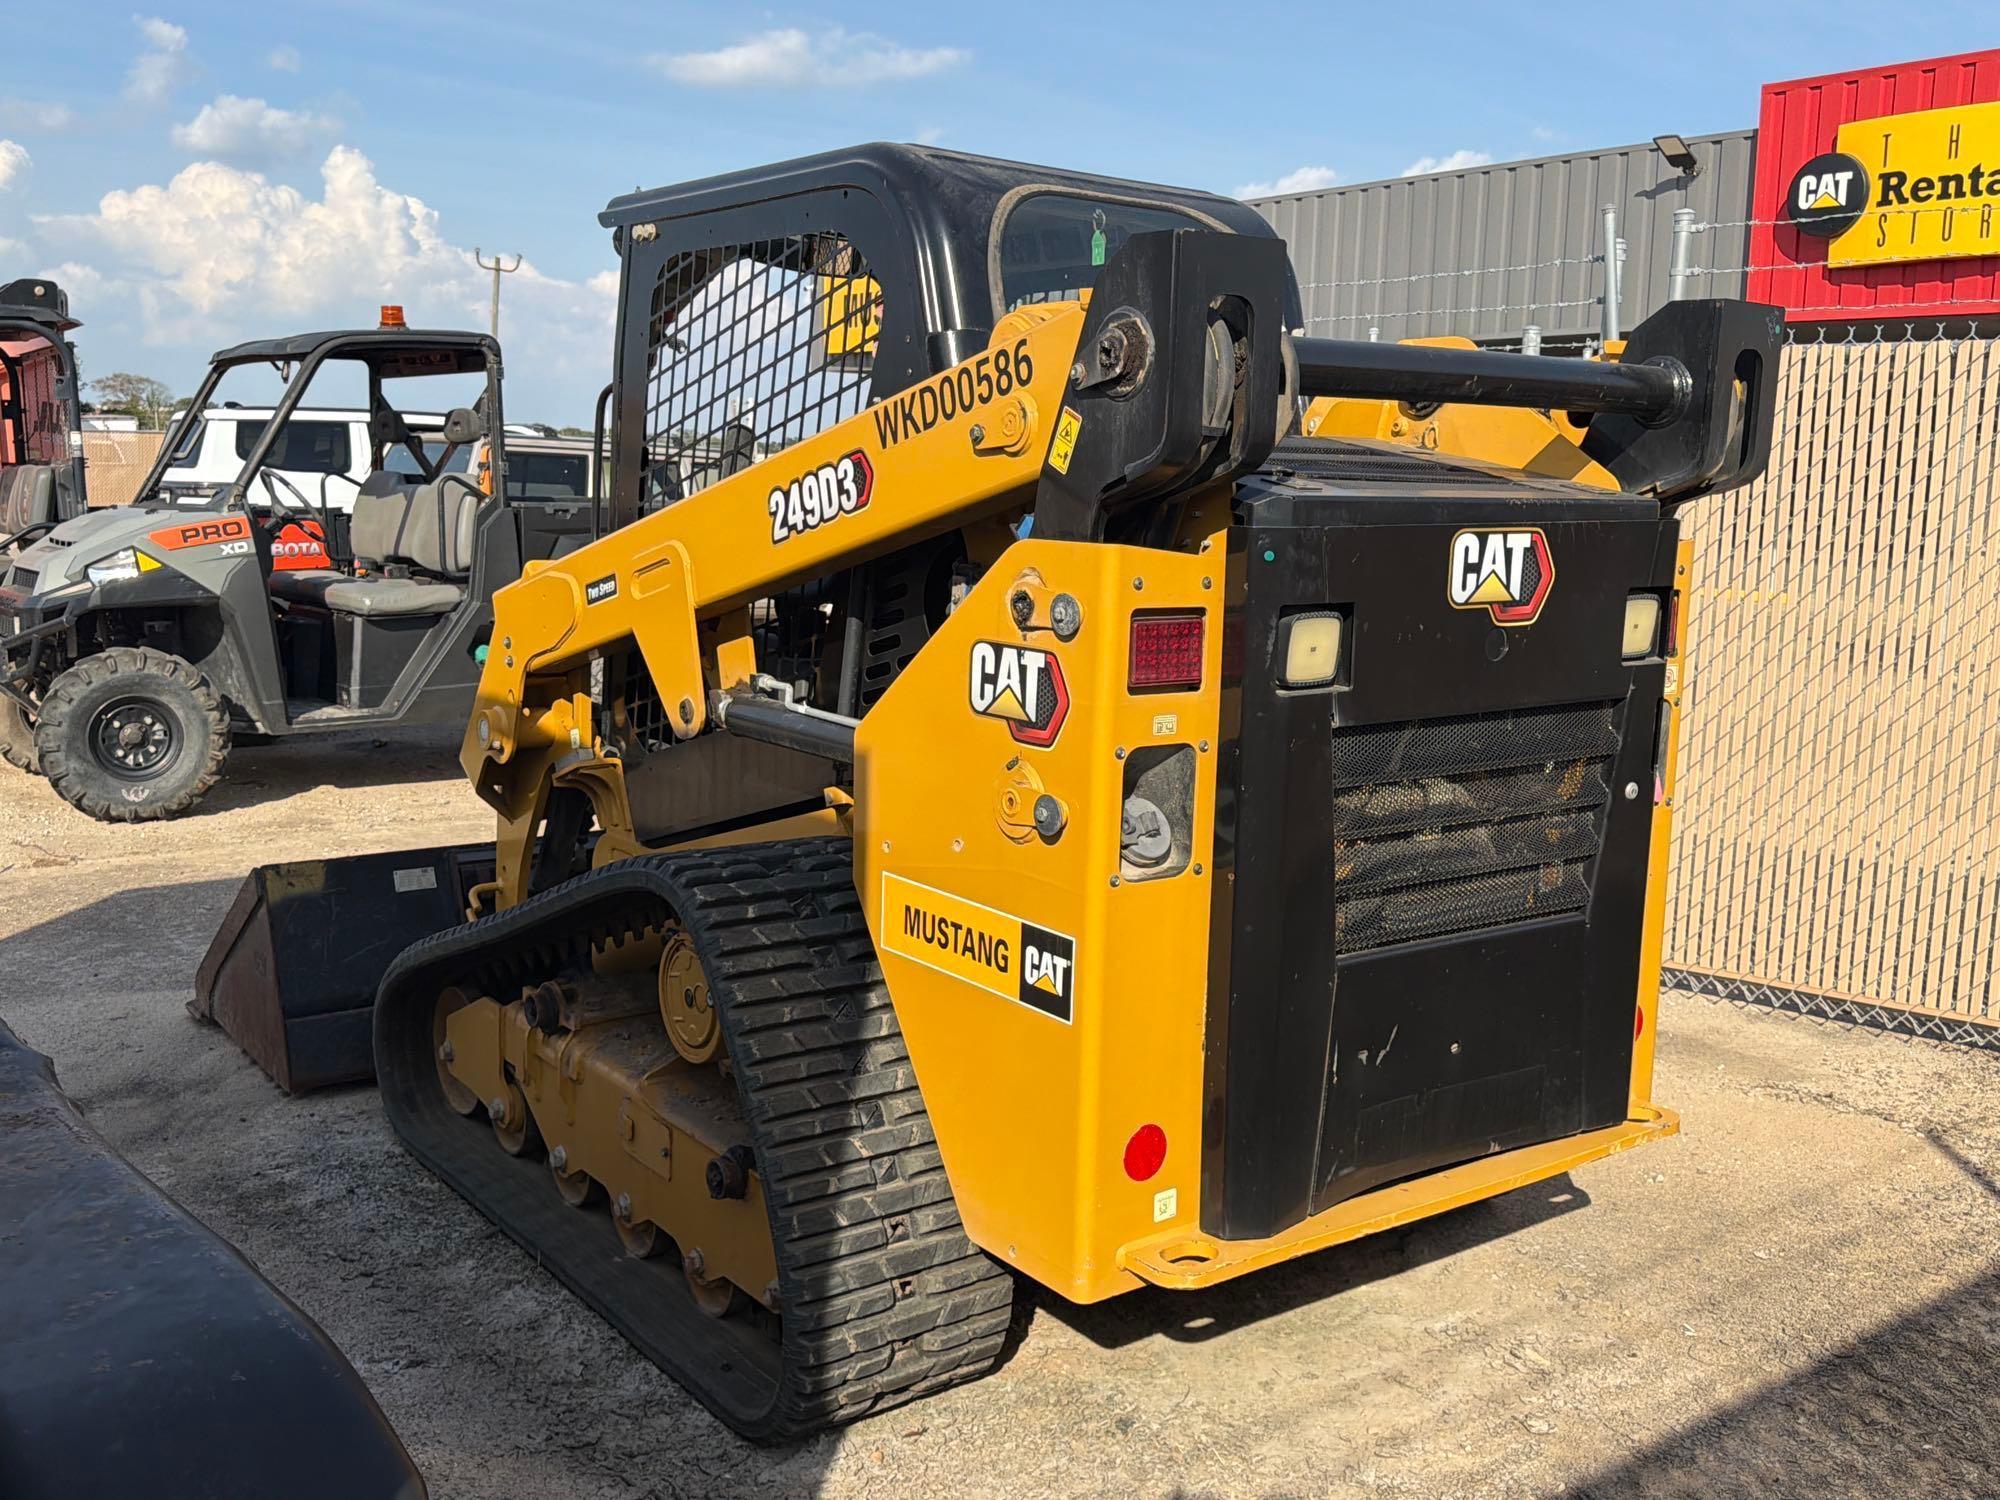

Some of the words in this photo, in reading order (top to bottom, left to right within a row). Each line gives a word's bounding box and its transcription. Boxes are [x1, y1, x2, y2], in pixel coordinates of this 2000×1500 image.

[1798, 171, 1853, 210] CAT
[873, 338, 1034, 450] WKD00586
[181, 521, 243, 543] PRO
[769, 457, 858, 542] 249D3
[219, 541, 249, 556] XD
[1451, 532, 1532, 604] CAT
[971, 642, 1046, 723] CAT
[904, 904, 1009, 974] MUSTANG
[1024, 945, 1068, 998] CAT
